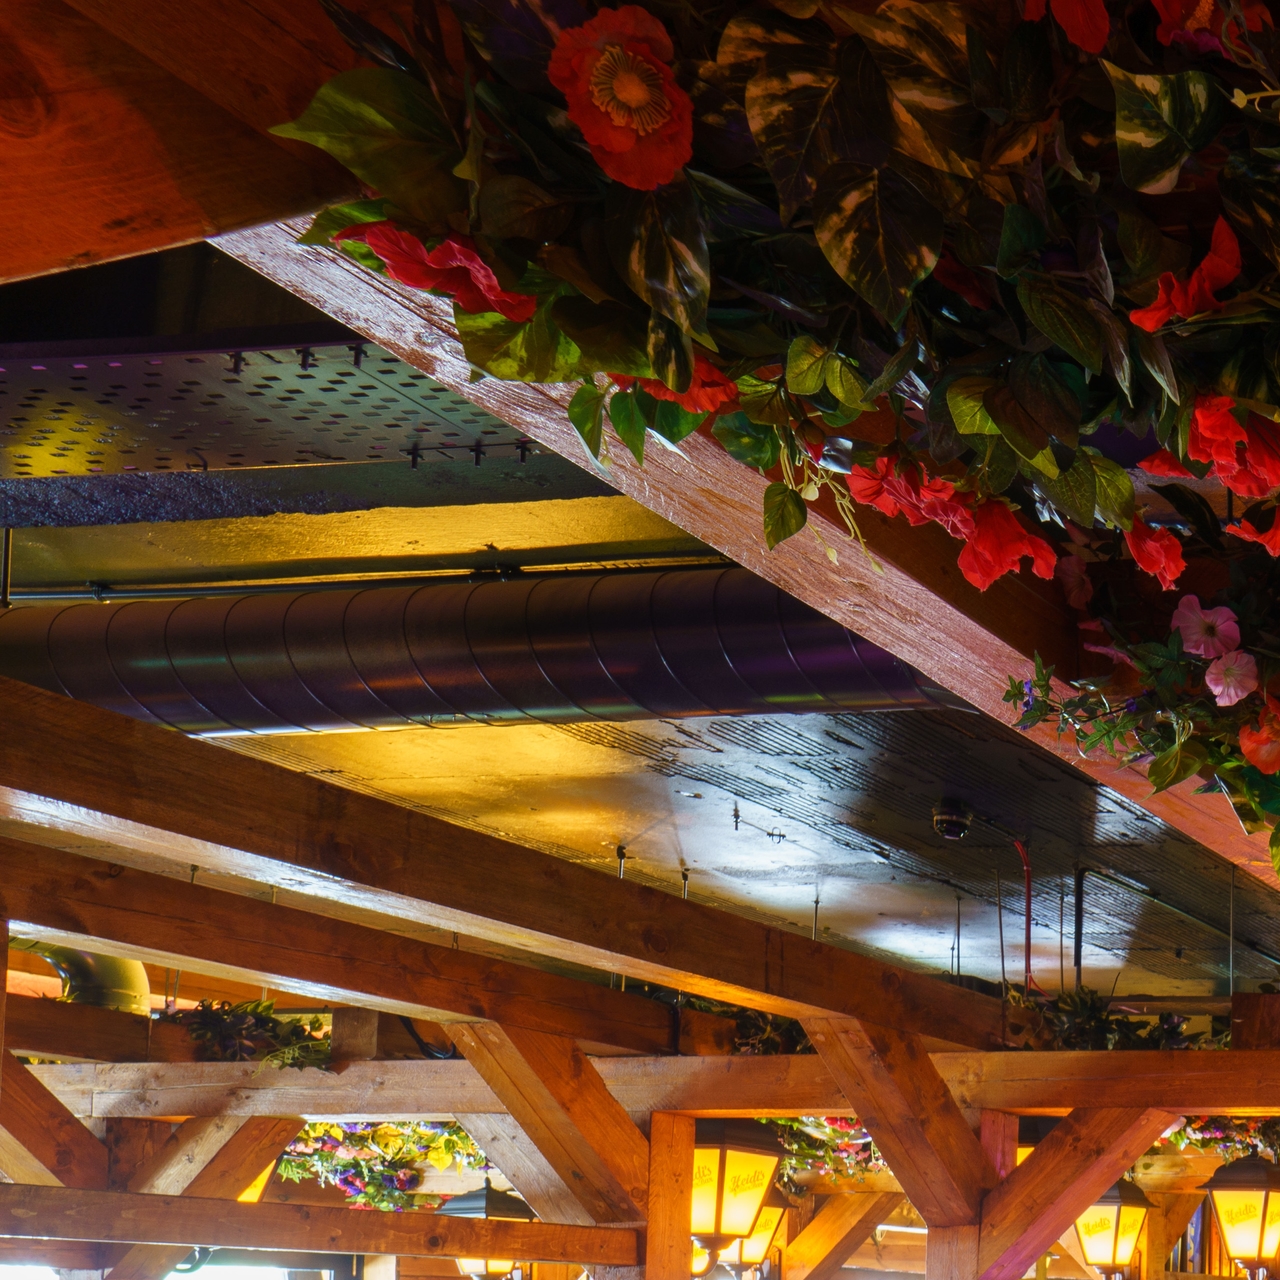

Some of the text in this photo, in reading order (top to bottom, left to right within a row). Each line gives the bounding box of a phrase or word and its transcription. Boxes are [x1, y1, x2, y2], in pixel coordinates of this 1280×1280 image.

[695, 1165, 712, 1180] di's
[730, 1169, 765, 1191] Heidi's
[1224, 1204, 1257, 1222] Heidi's
[1082, 1217, 1111, 1234] Heidi's
